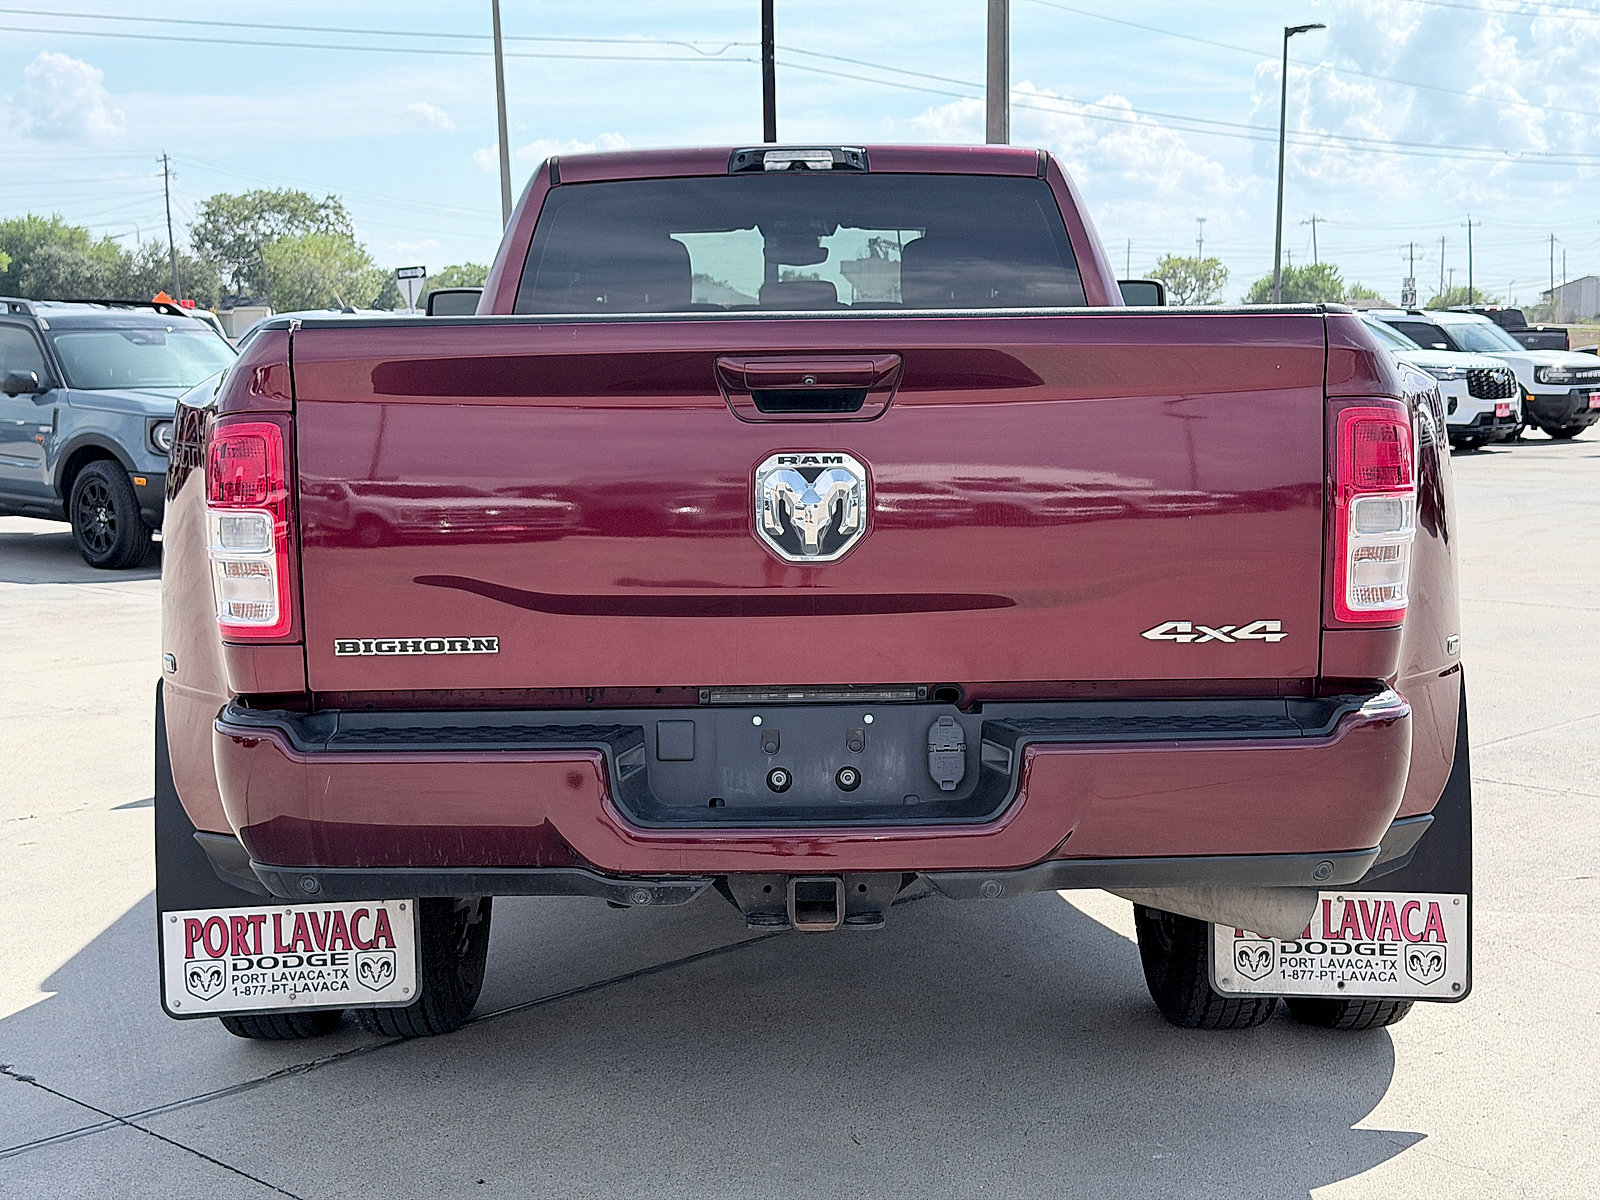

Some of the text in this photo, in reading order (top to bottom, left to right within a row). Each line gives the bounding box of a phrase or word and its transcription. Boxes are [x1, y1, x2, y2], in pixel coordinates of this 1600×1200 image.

[777, 456, 843, 465] RAM
[1140, 620, 1289, 643] 4x4
[335, 636, 499, 656] BIGHORN
[1321, 899, 1448, 943] LAVACA
[183, 908, 397, 959] PORT LAVACA
[1281, 941, 1398, 956] DODGE
[232, 952, 349, 971] DODGE
[1280, 957, 1316, 968] PORT
[232, 972, 268, 985] PORT
[1280, 970, 1398, 982] 1-877-PT-LAVACA
[232, 980, 350, 997] 1-877-PT-LAVACA
